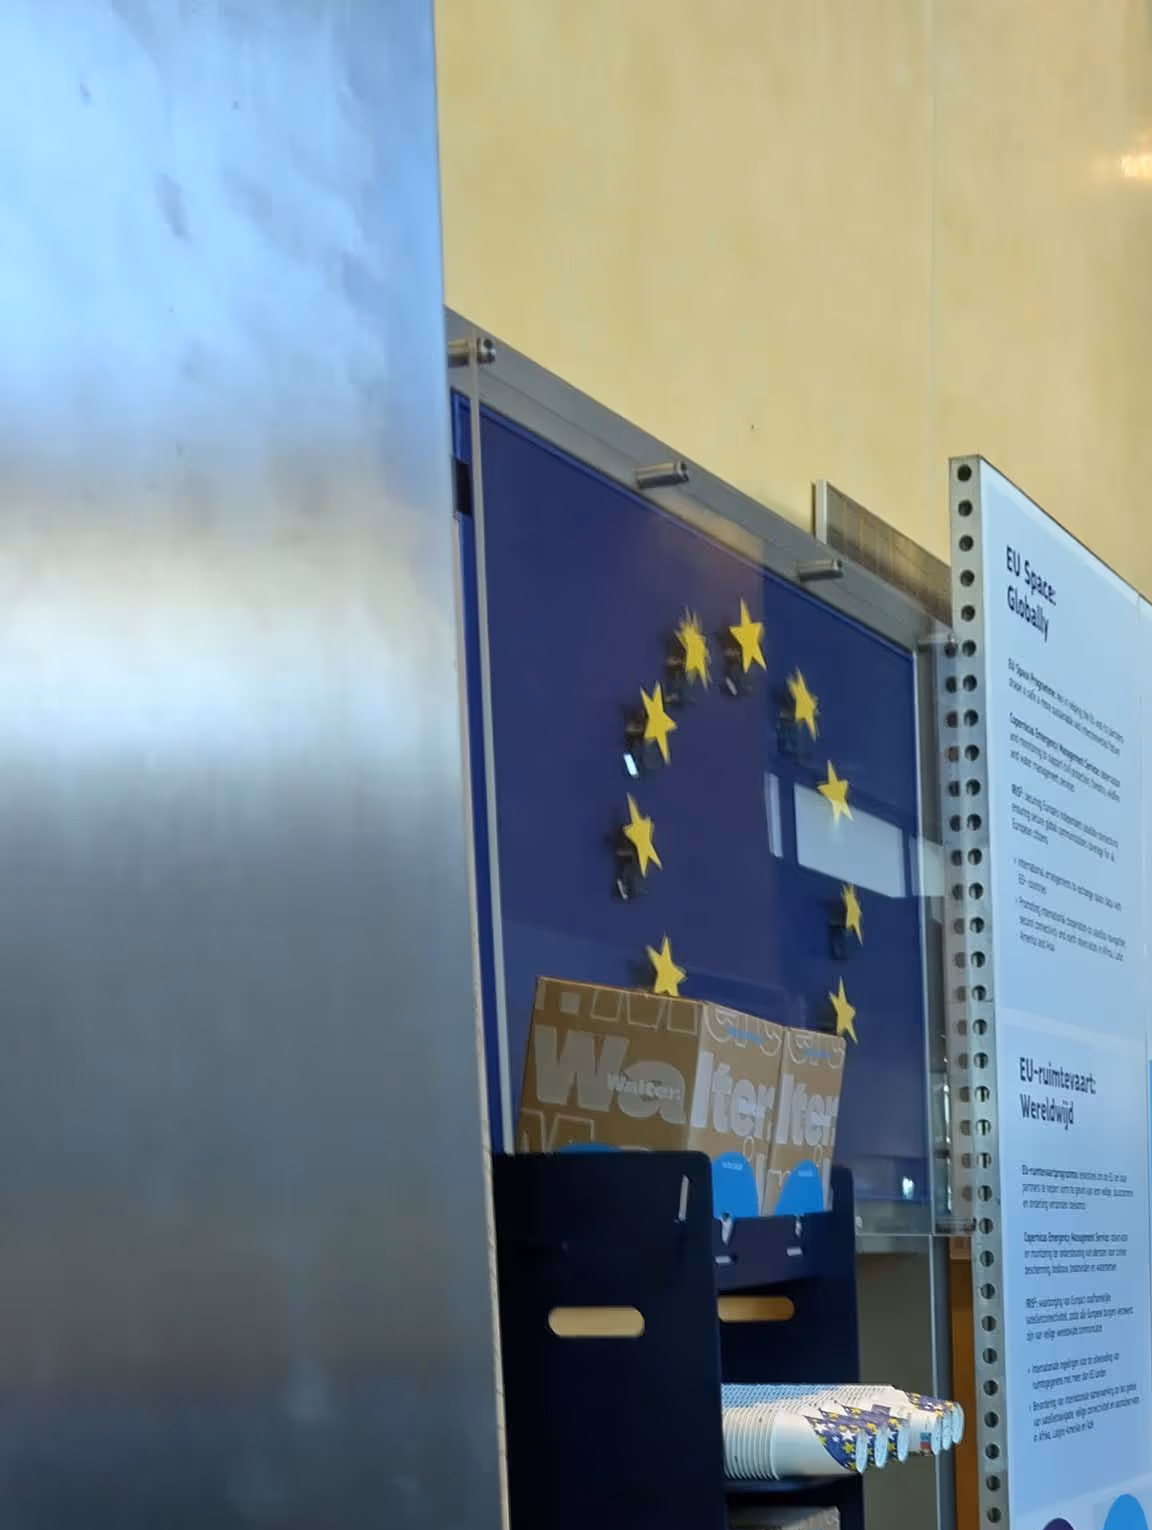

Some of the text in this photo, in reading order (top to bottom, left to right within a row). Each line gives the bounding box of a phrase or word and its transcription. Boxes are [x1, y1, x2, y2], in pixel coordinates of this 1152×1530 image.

[1006, 545, 1021, 577] EU
[1007, 584, 1049, 643] Globally
[1019, 1093, 1074, 1131] Wereldwijd
